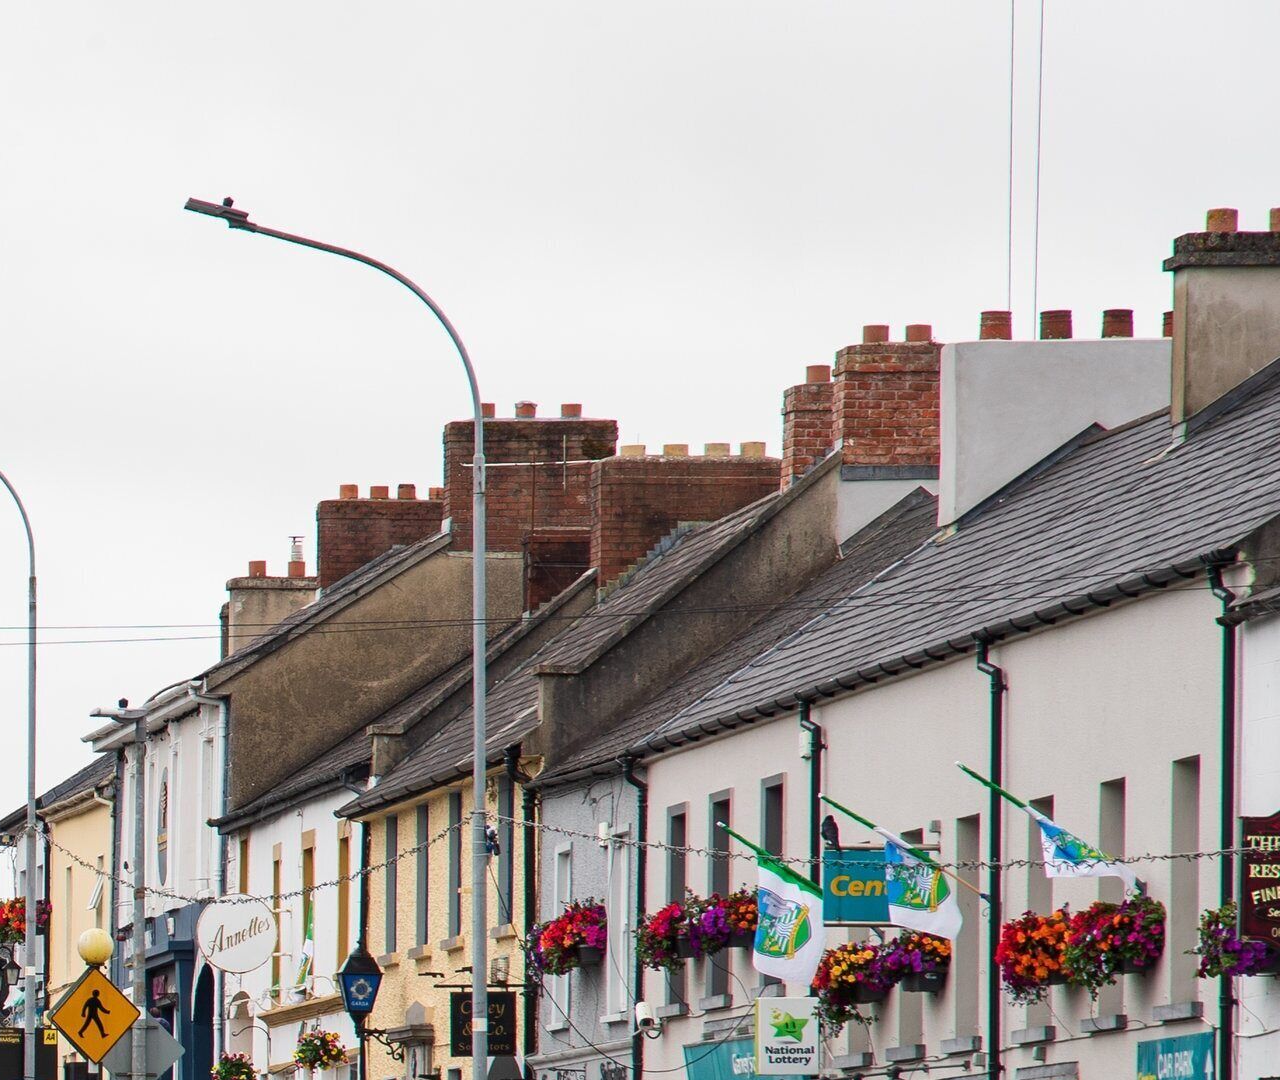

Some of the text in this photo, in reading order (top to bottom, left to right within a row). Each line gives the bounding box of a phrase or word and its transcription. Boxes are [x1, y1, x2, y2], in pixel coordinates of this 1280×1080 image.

[830, 875, 887, 897] Cen
[207, 916, 271, 957] Annettes
[461, 1000, 505, 1019] Cey
[765, 1046, 815, 1054] National
[768, 1056, 811, 1066] Lottery
[1157, 1050, 1194, 1080] CAR PARK
